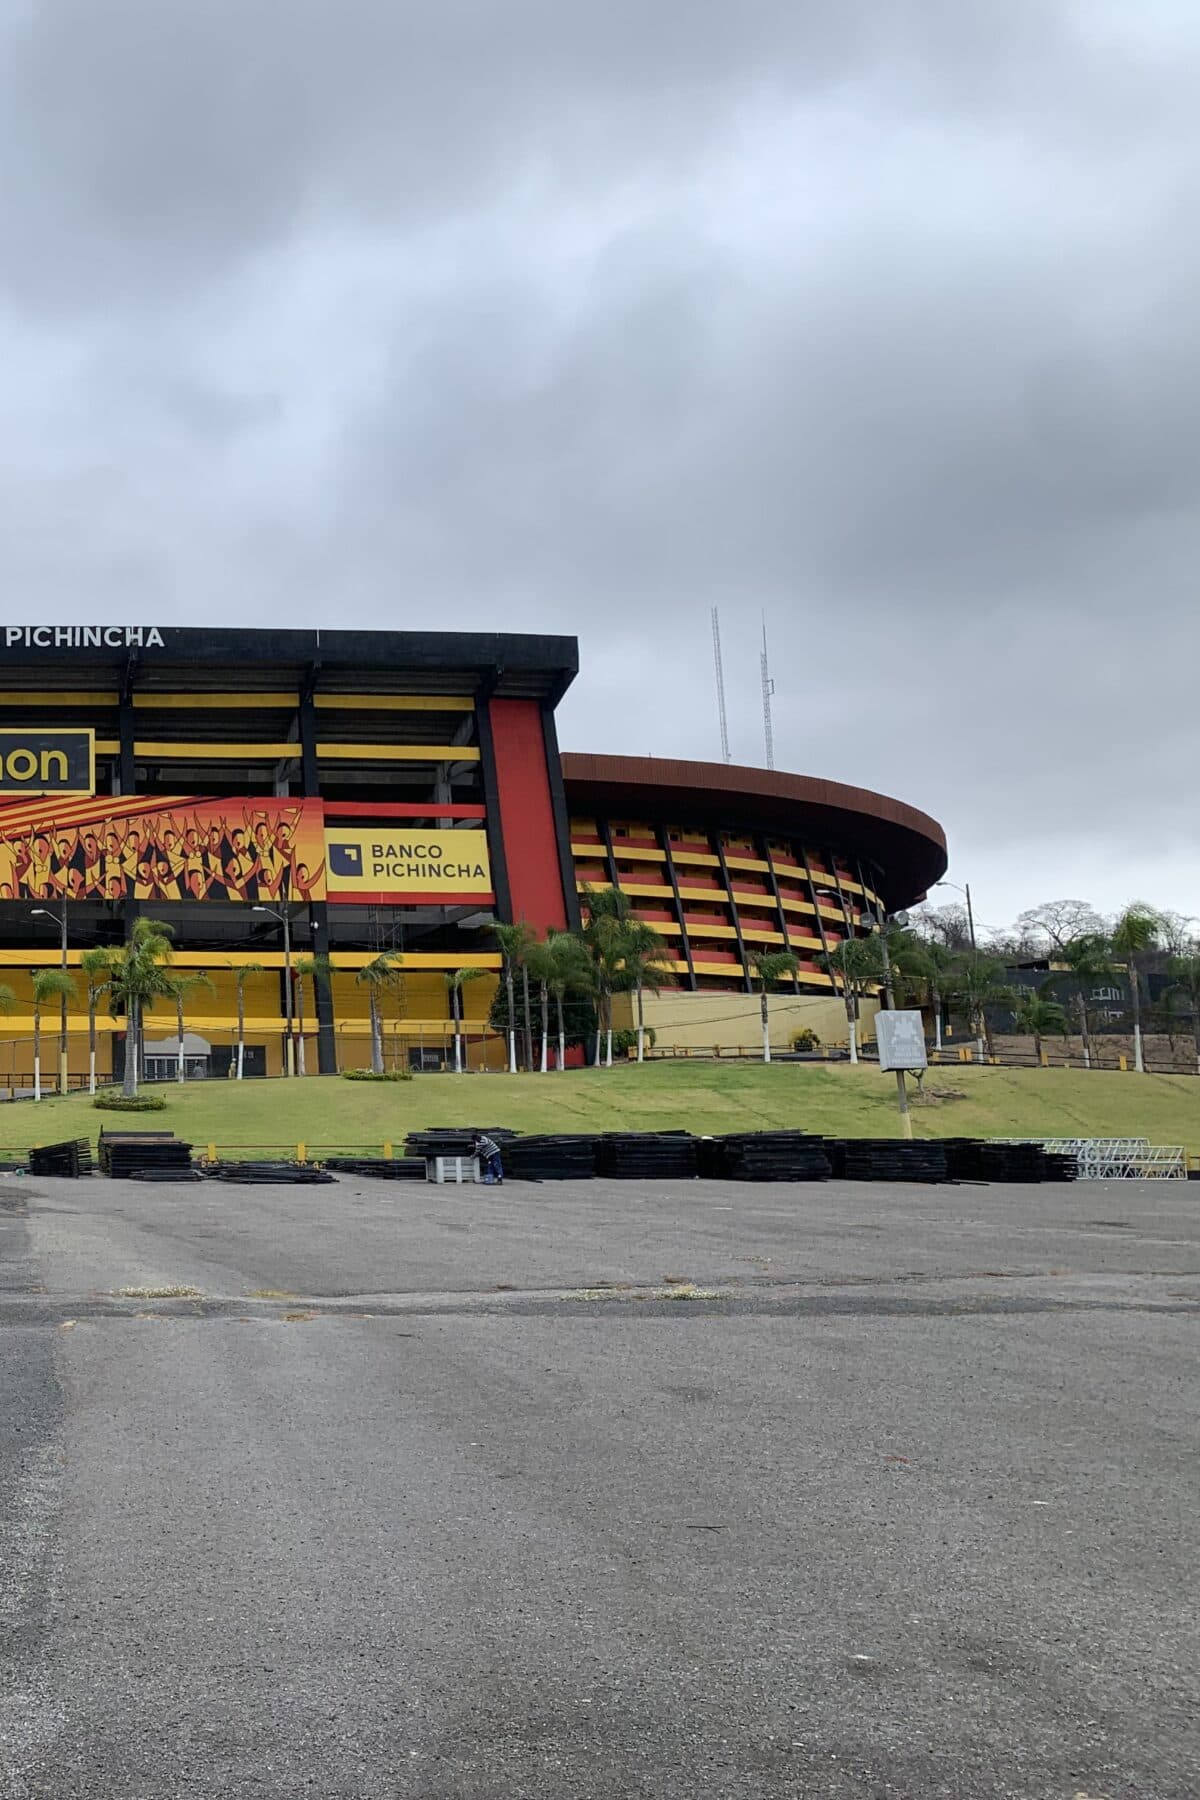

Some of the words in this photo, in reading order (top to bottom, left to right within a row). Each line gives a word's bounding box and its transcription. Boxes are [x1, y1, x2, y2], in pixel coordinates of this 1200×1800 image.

[6, 626, 166, 648] PICHINCHA
[371, 844, 443, 859] BANCO
[373, 863, 486, 879] PICHINCHA
